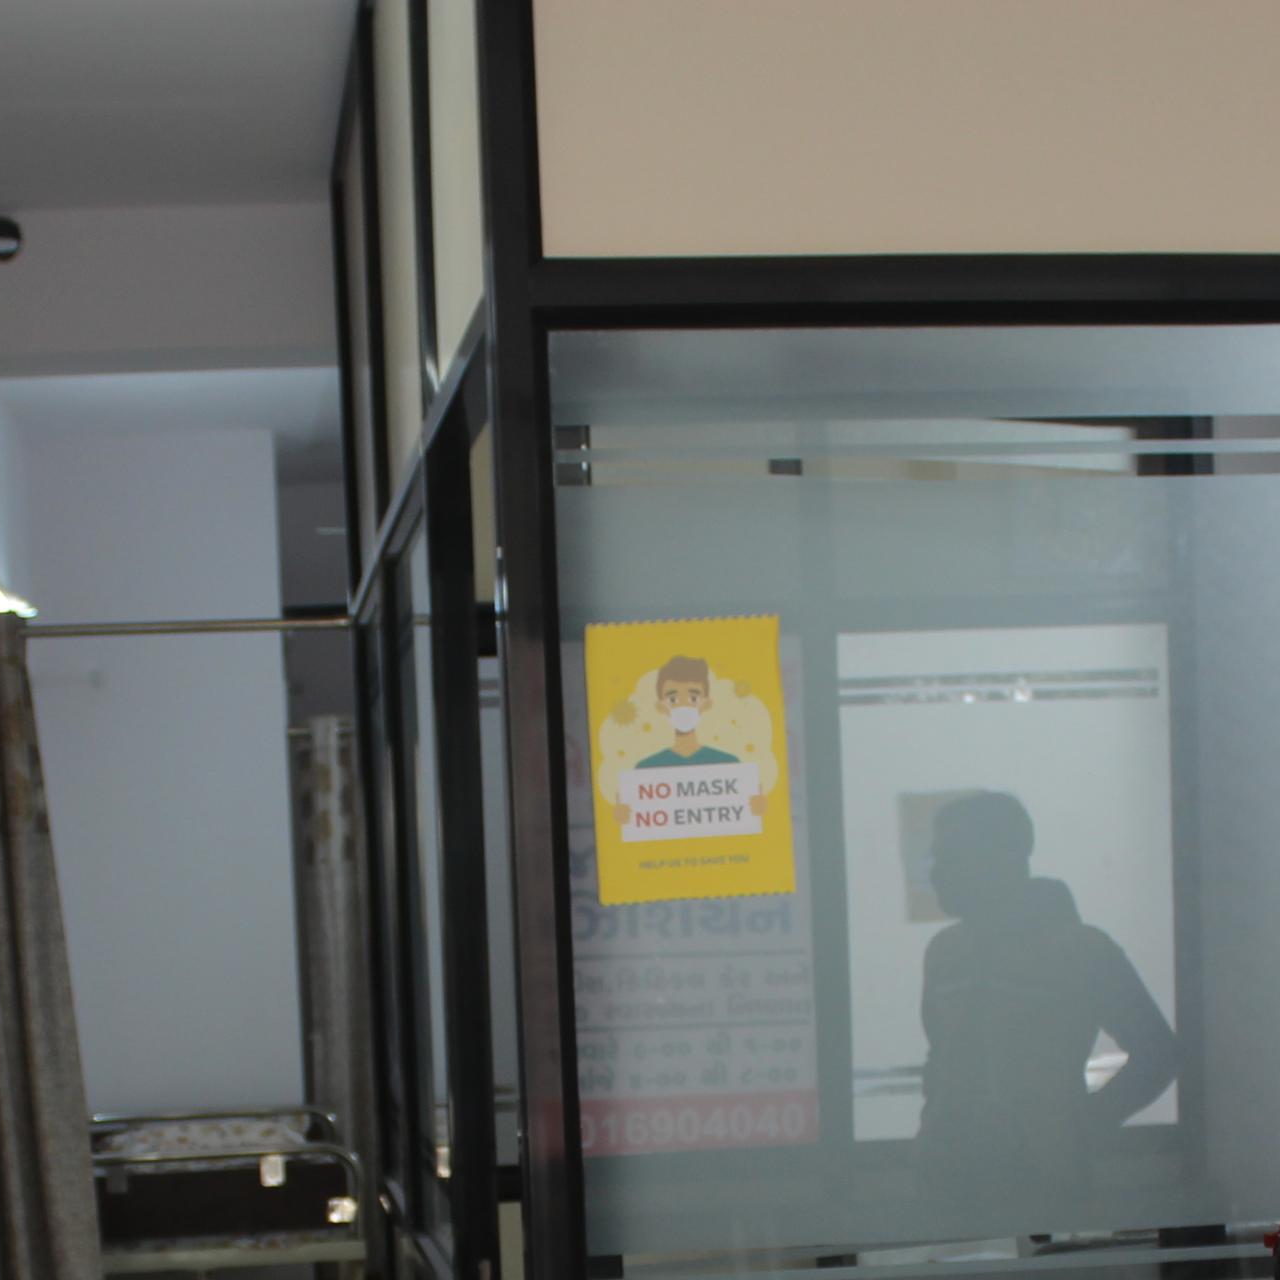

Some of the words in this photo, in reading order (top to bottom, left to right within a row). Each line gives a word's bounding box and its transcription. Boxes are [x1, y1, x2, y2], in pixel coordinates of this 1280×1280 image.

[638, 783, 672, 800] NO
[676, 778, 739, 798] MASK
[635, 810, 669, 828] NO
[674, 805, 744, 825] ENTRY
